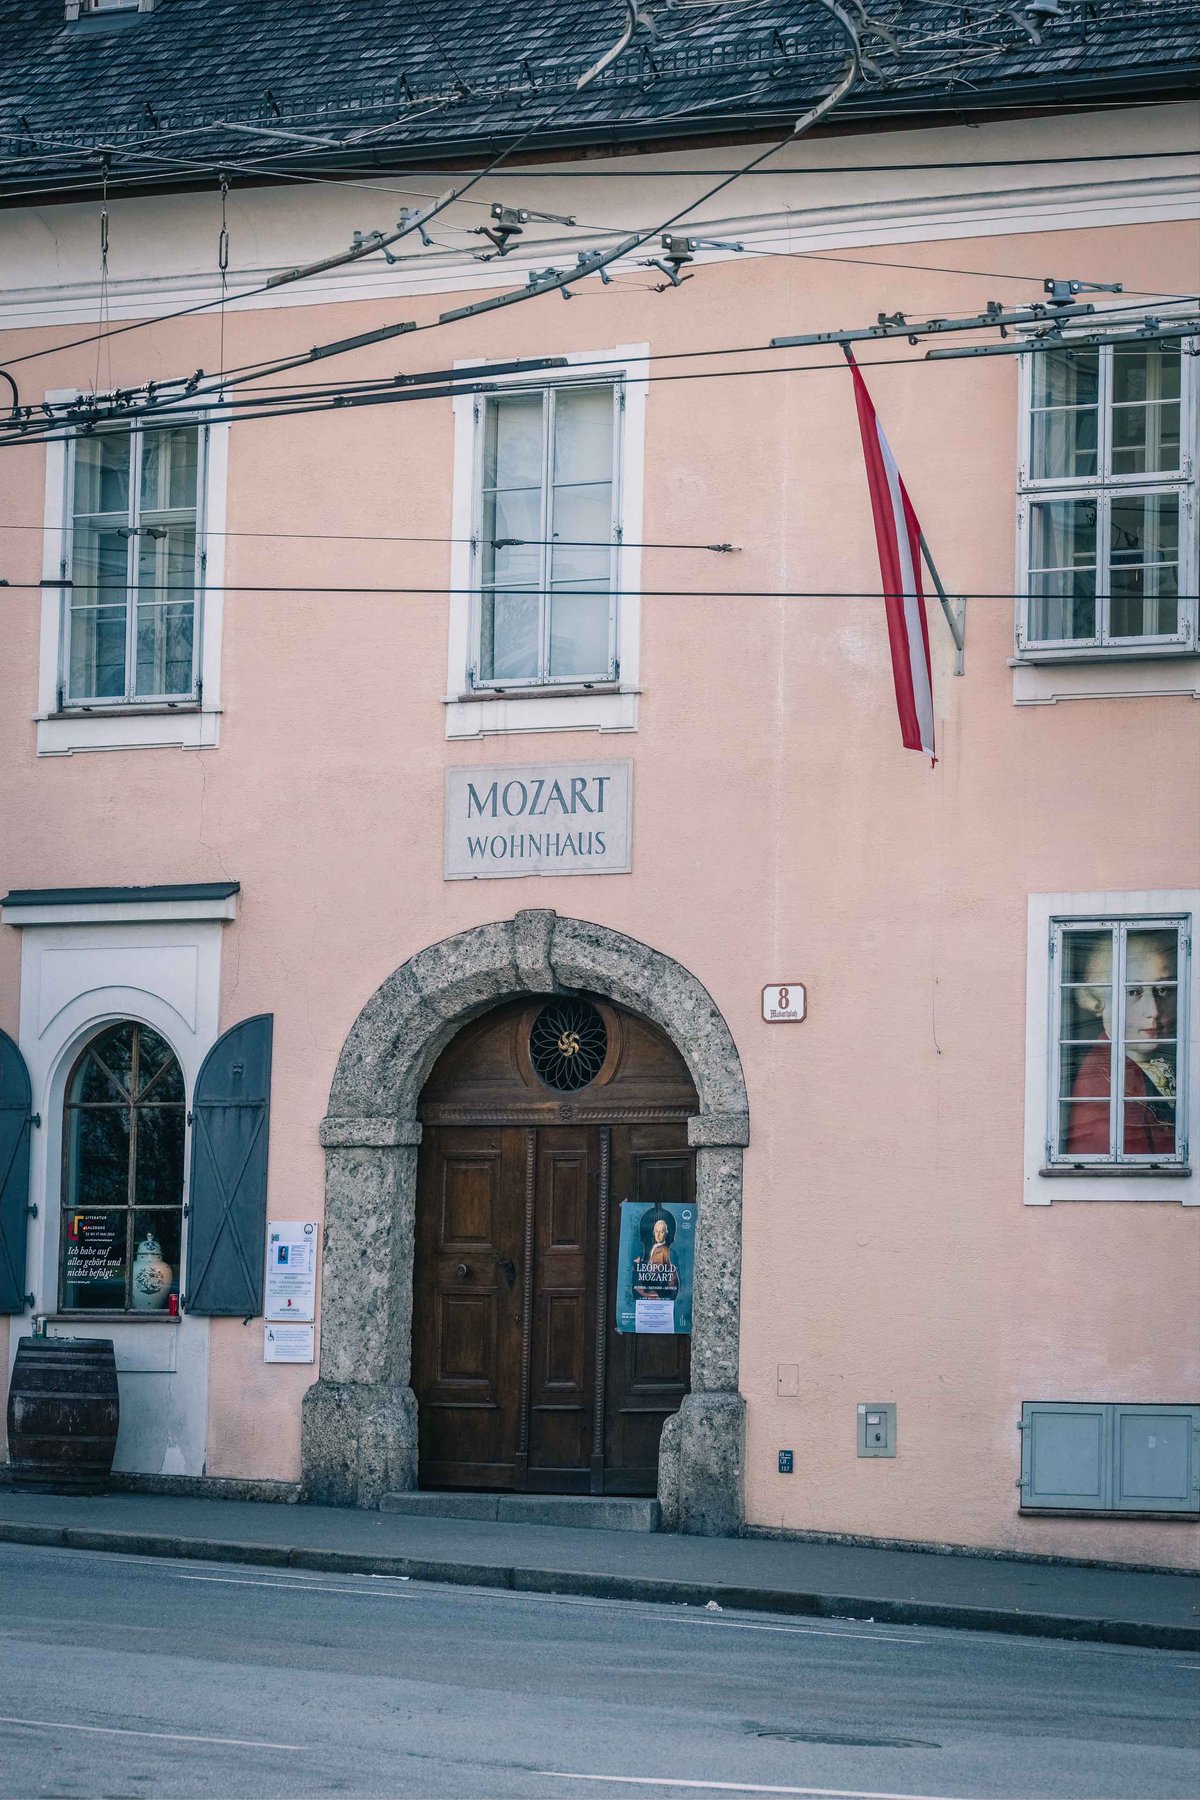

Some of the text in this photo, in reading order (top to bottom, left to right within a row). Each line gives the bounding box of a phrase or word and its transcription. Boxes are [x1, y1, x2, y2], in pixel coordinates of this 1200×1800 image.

[467, 776, 611, 818] MOZART
[467, 831, 607, 859] WOHNHAUS
[778, 987, 790, 1009] 8
[67, 1246, 112, 1258] Ich habe auf
[67, 1257, 122, 1268] alles gehört und
[636, 1263, 677, 1273] LEOPOLD
[67, 1268, 88, 1277] nichts
[638, 1272, 674, 1282] MOZART
